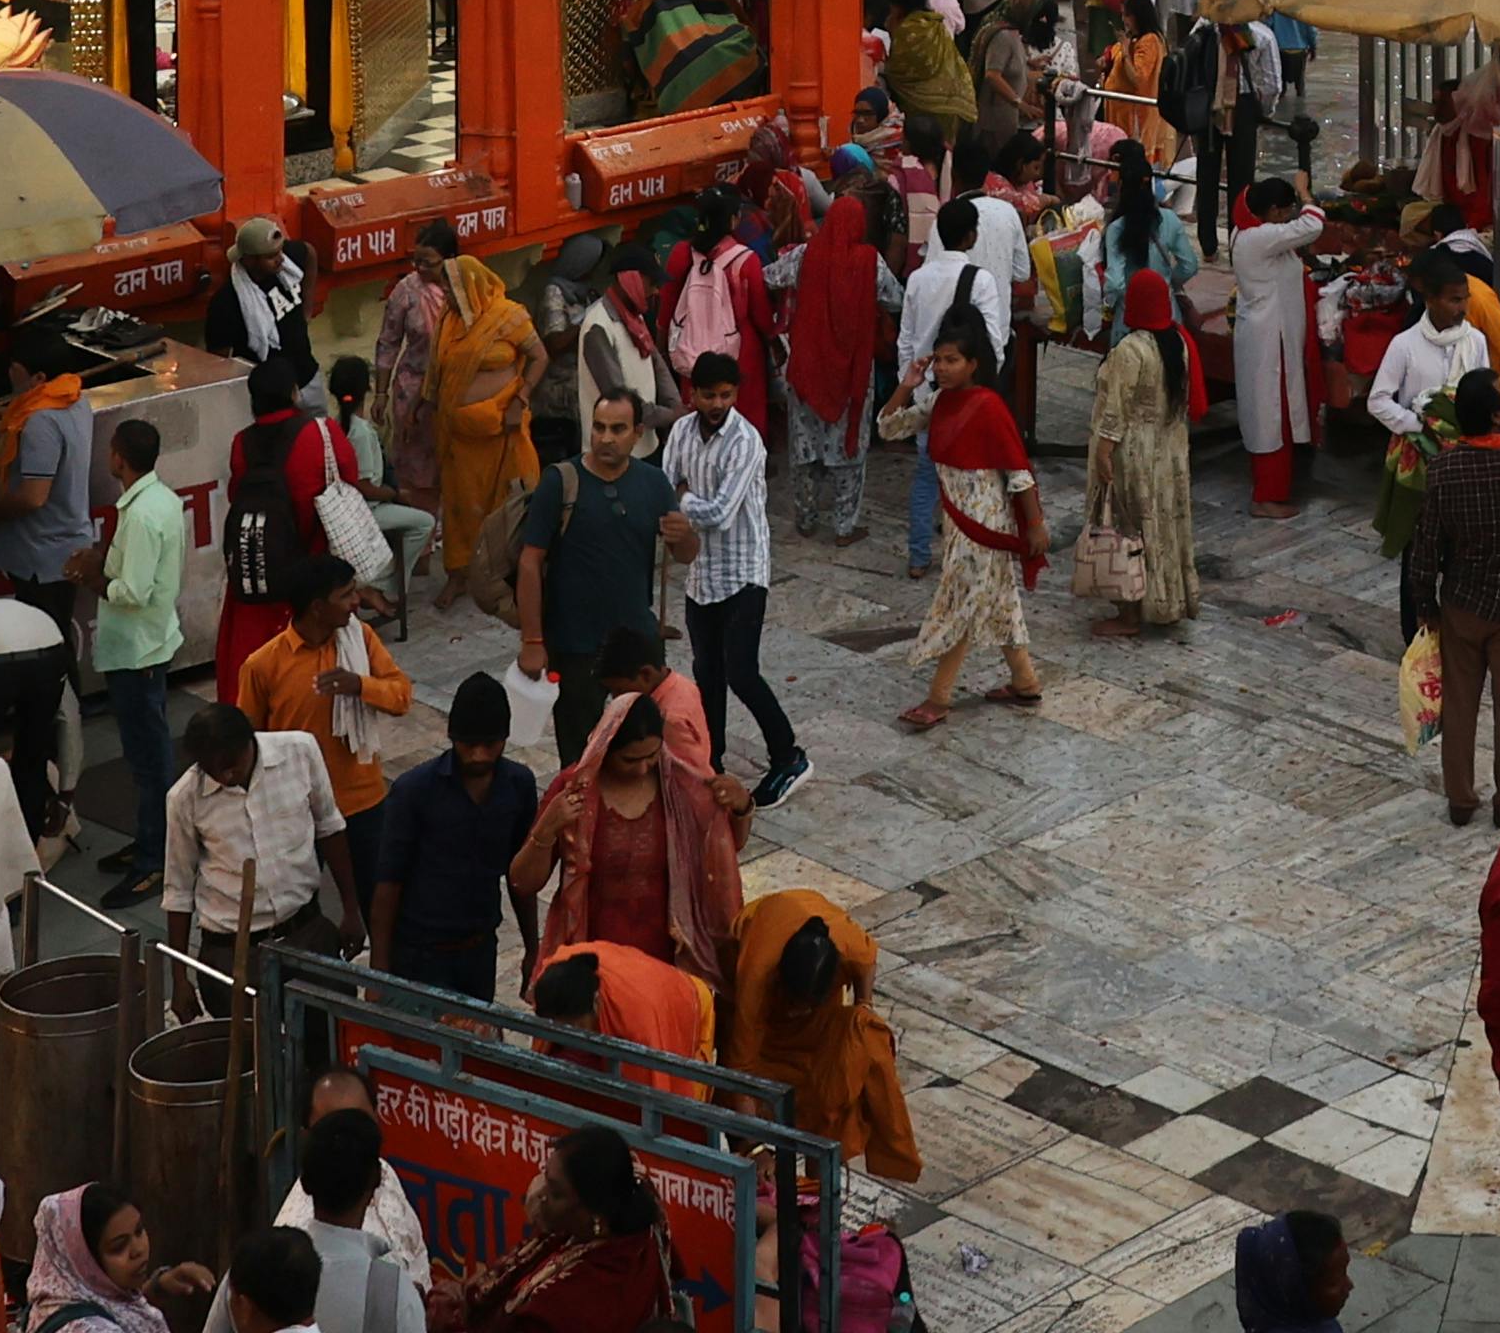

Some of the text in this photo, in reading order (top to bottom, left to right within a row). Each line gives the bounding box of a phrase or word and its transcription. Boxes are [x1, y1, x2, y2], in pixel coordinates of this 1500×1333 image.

[455, 205, 508, 238] दान पात्र
[113, 258, 184, 298] दान पात्र
[376, 1083, 403, 1125] हर
[402, 1084, 431, 1133] की
[470, 1103, 509, 1158] क्षेत्र
[510, 1114, 530, 1160] में
[690, 1179, 725, 1221] मना
